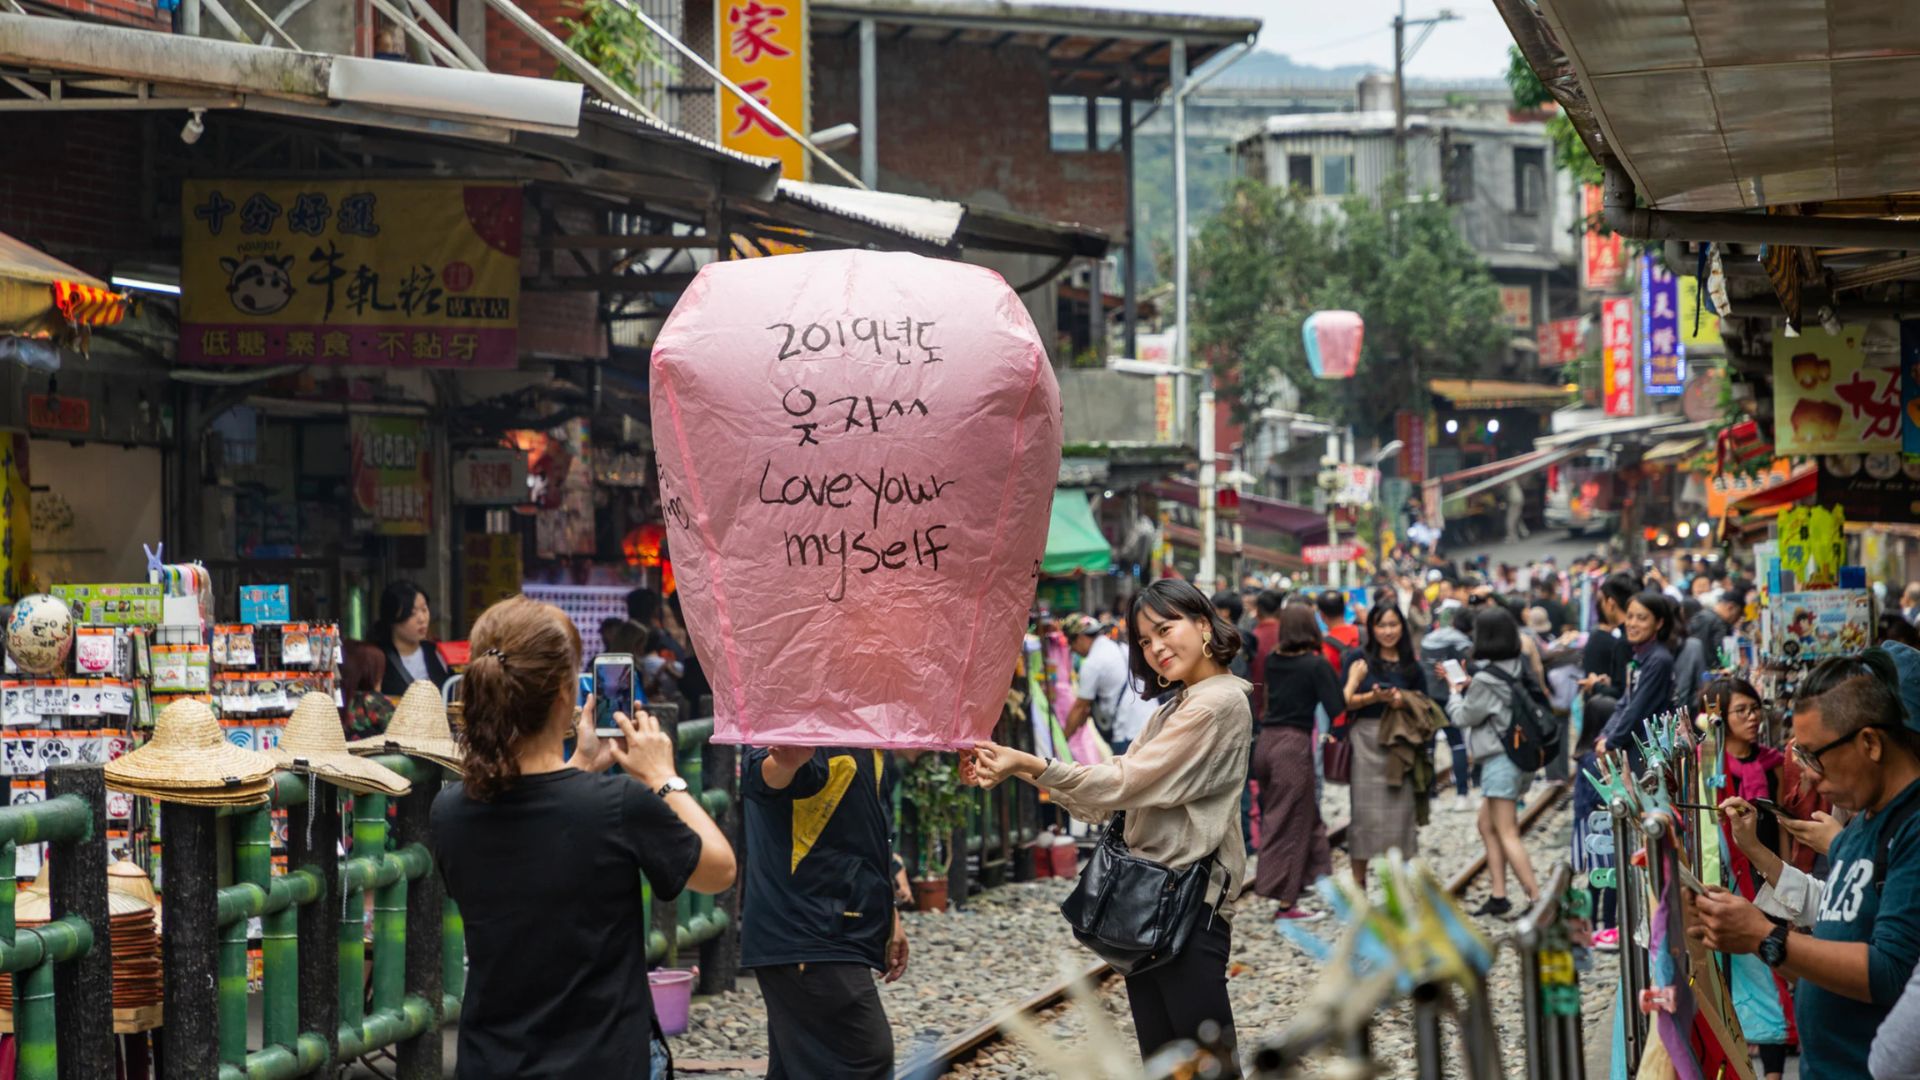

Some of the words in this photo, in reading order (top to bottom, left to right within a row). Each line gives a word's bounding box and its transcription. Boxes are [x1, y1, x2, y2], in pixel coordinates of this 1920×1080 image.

[195, 190, 380, 237] 十分好運
[307, 240, 443, 323] 牛軋糖
[766, 315, 944, 366] 2019년도
[784, 524, 950, 603] myself
